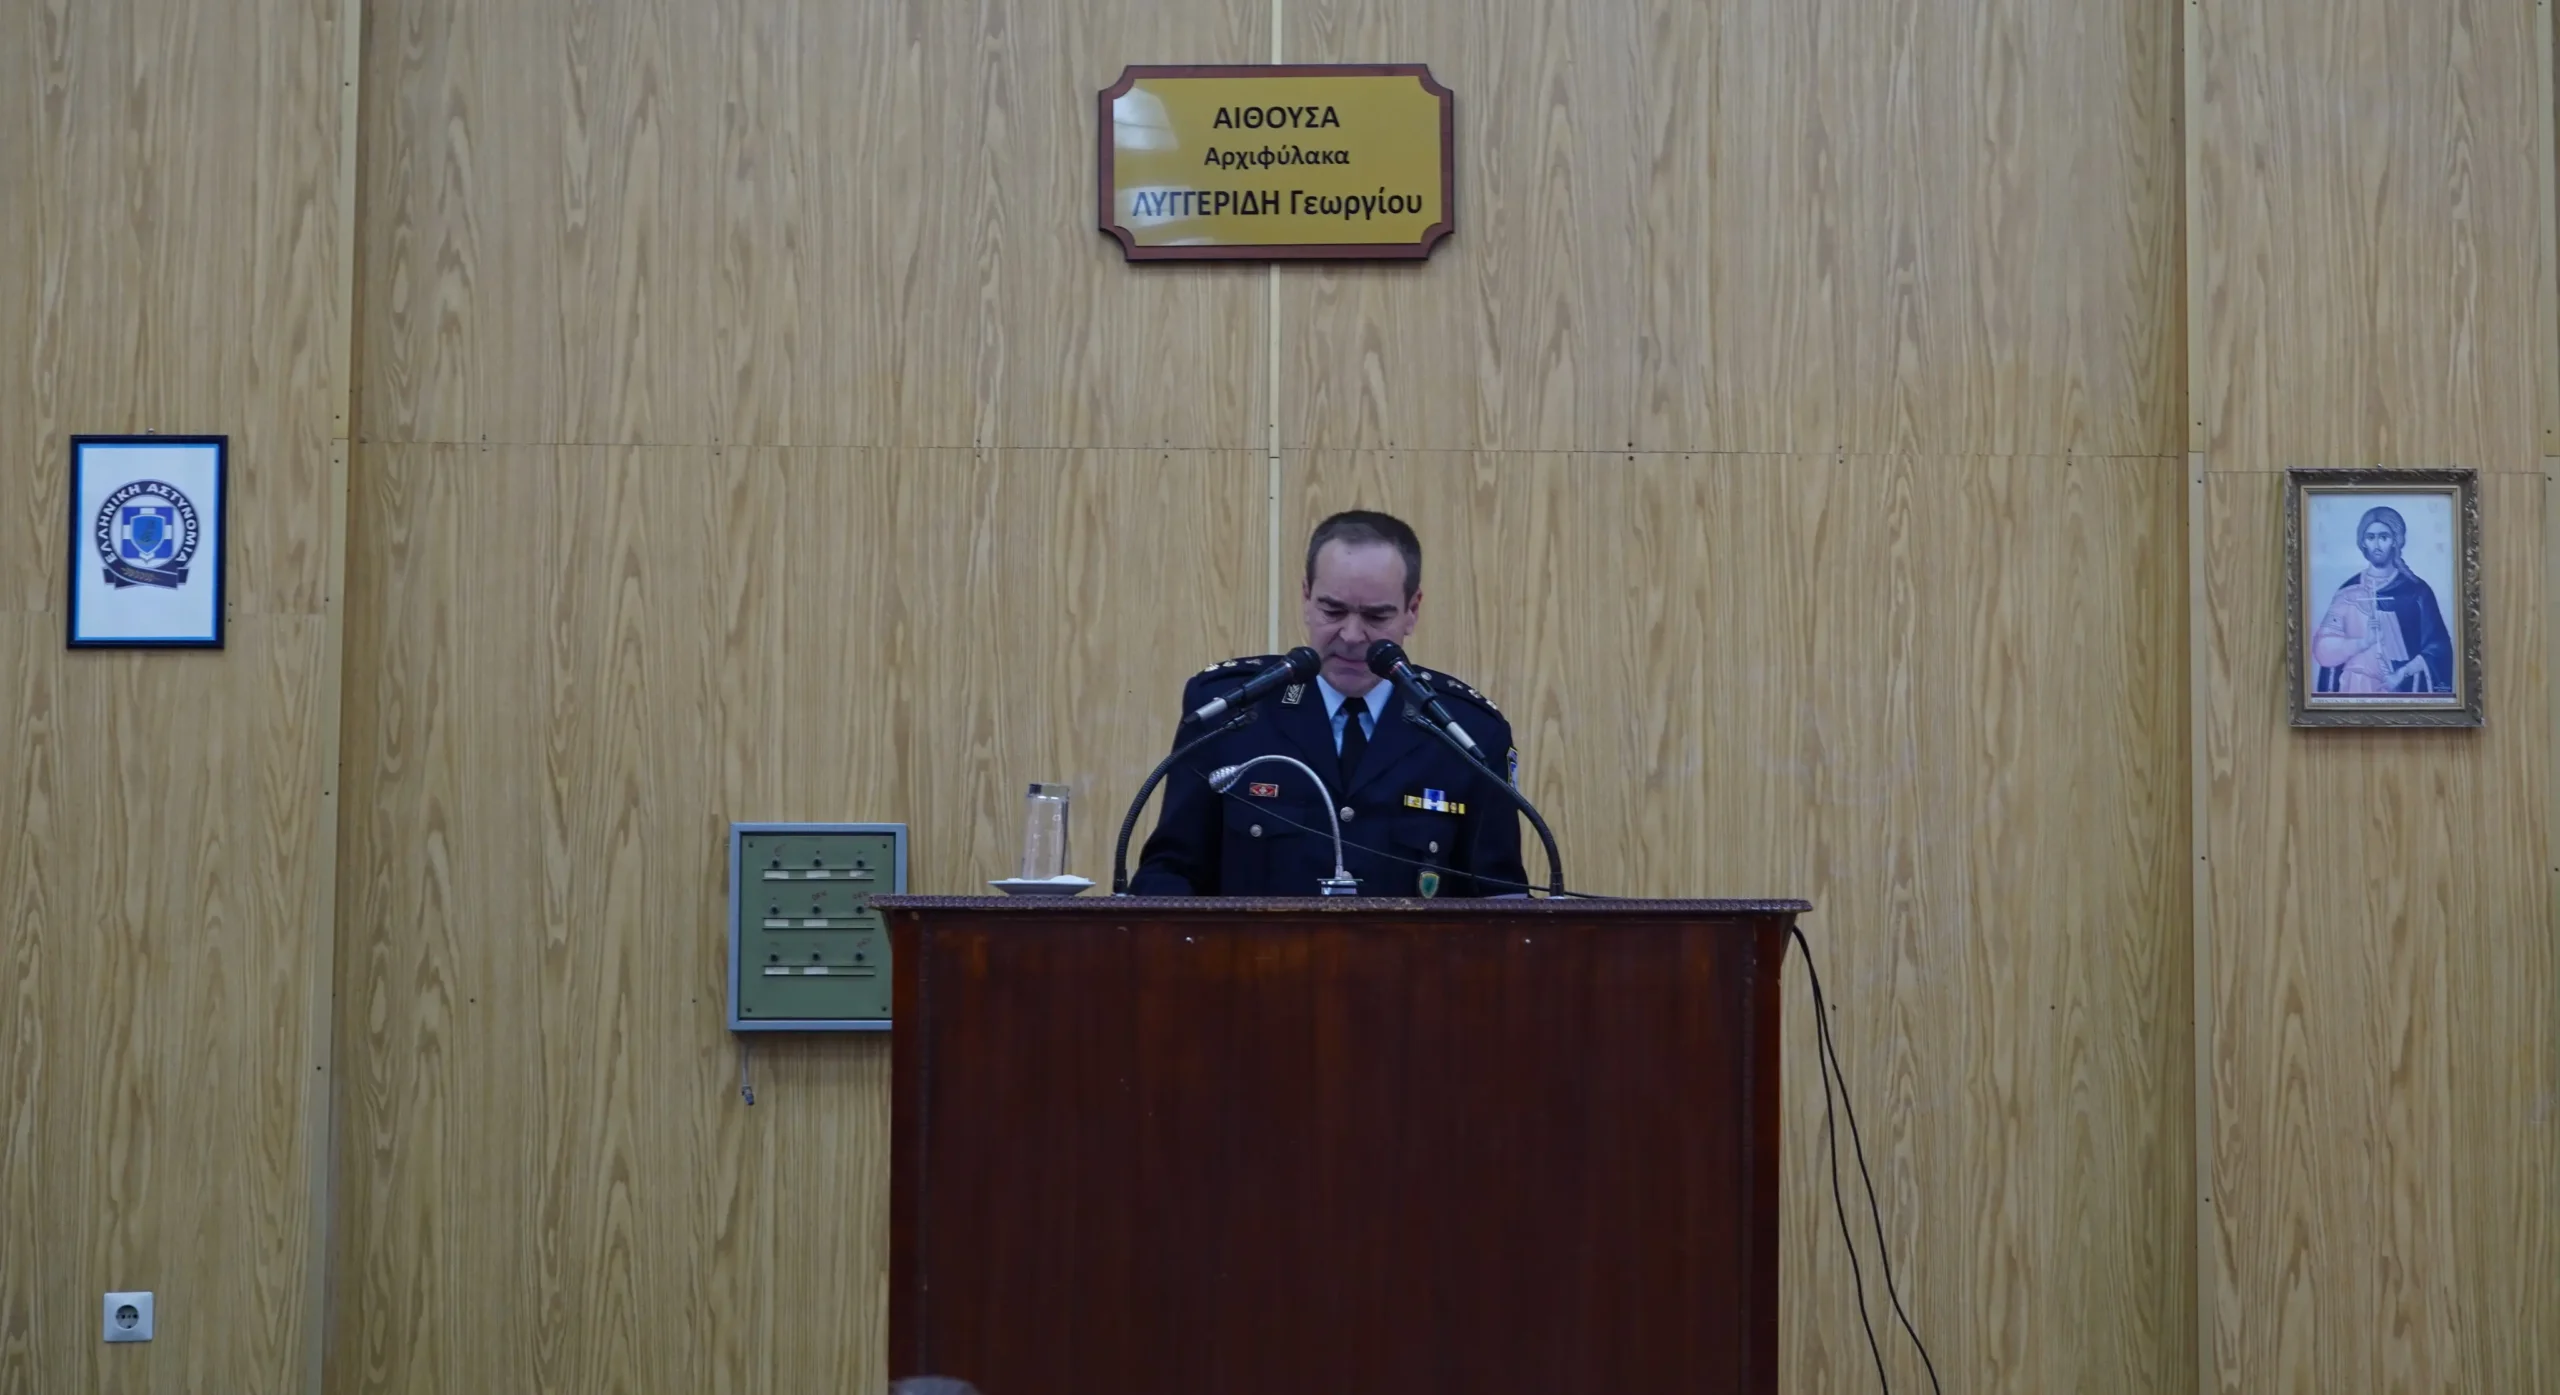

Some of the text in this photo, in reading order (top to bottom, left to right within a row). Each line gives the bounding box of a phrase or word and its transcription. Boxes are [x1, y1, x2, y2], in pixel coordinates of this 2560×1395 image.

[1213, 106, 1340, 128] ΑΙΘΟΥΣΑ
[1204, 145, 1350, 170] Αρχιφύλακα
[1132, 187, 1422, 220] ΛΥΓΓΕΡΙΔΗ Γεωργίου
[98, 483, 199, 564] ΕΛΛΗΝΙΚΗ ΑΣΤΥΝΟΜΙΑ
